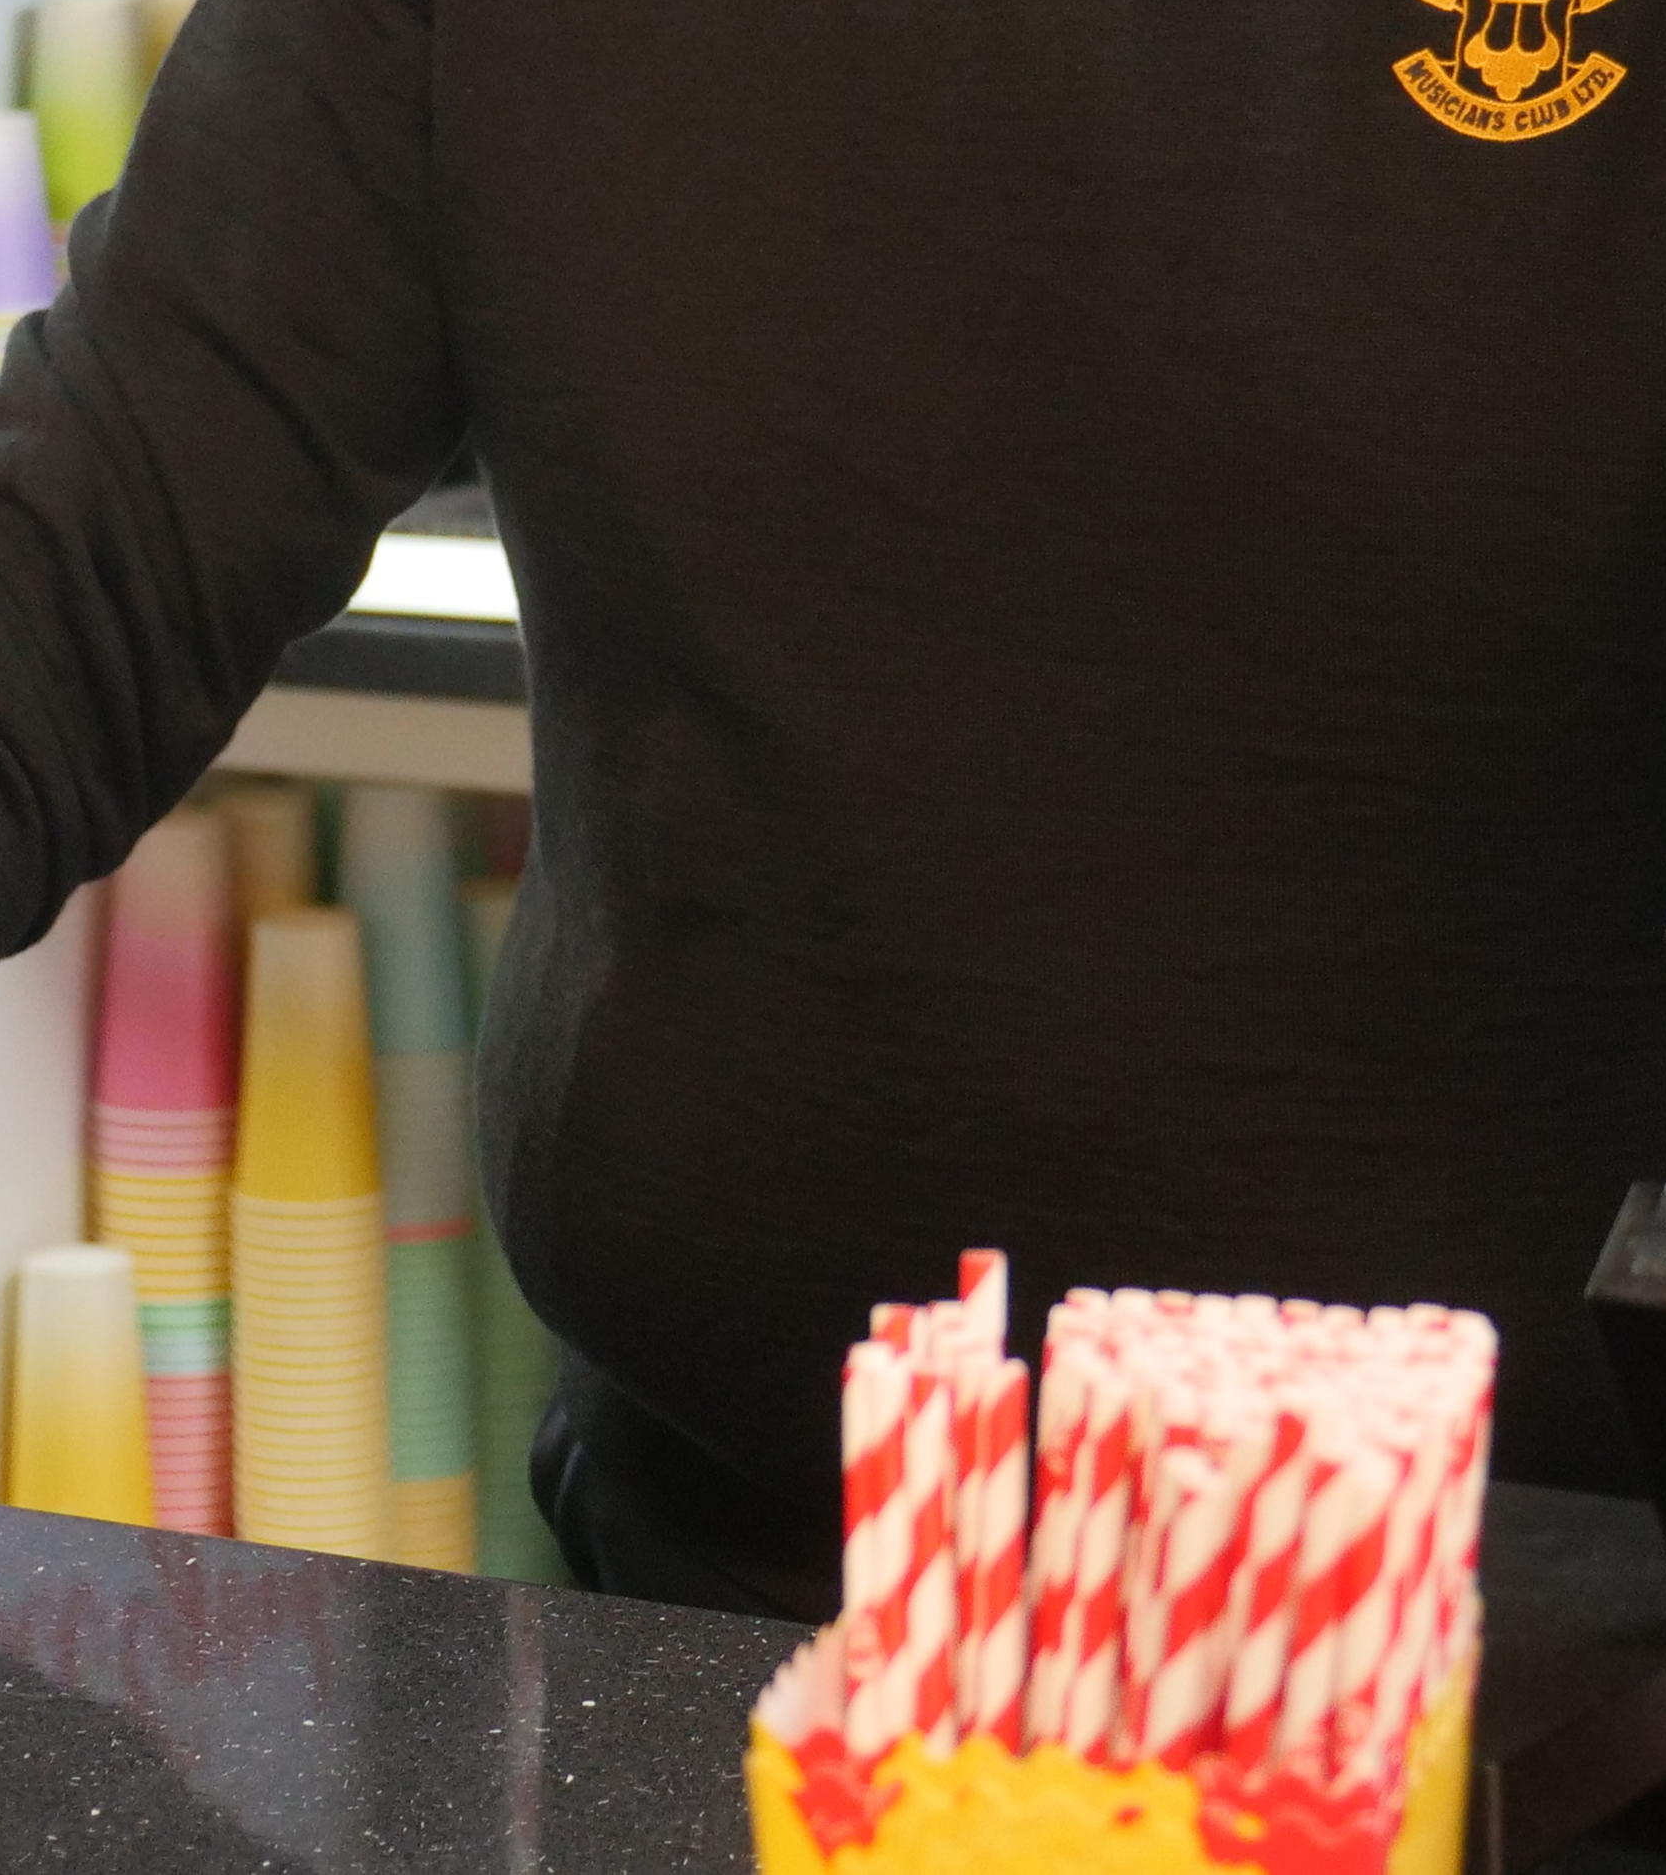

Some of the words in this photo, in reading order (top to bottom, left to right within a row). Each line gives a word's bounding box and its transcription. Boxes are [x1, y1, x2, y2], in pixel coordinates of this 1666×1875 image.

[1403, 59, 1506, 132] MUSICIANS
[1514, 97, 1572, 131] CLUB
[1571, 67, 1616, 109] LTD.
